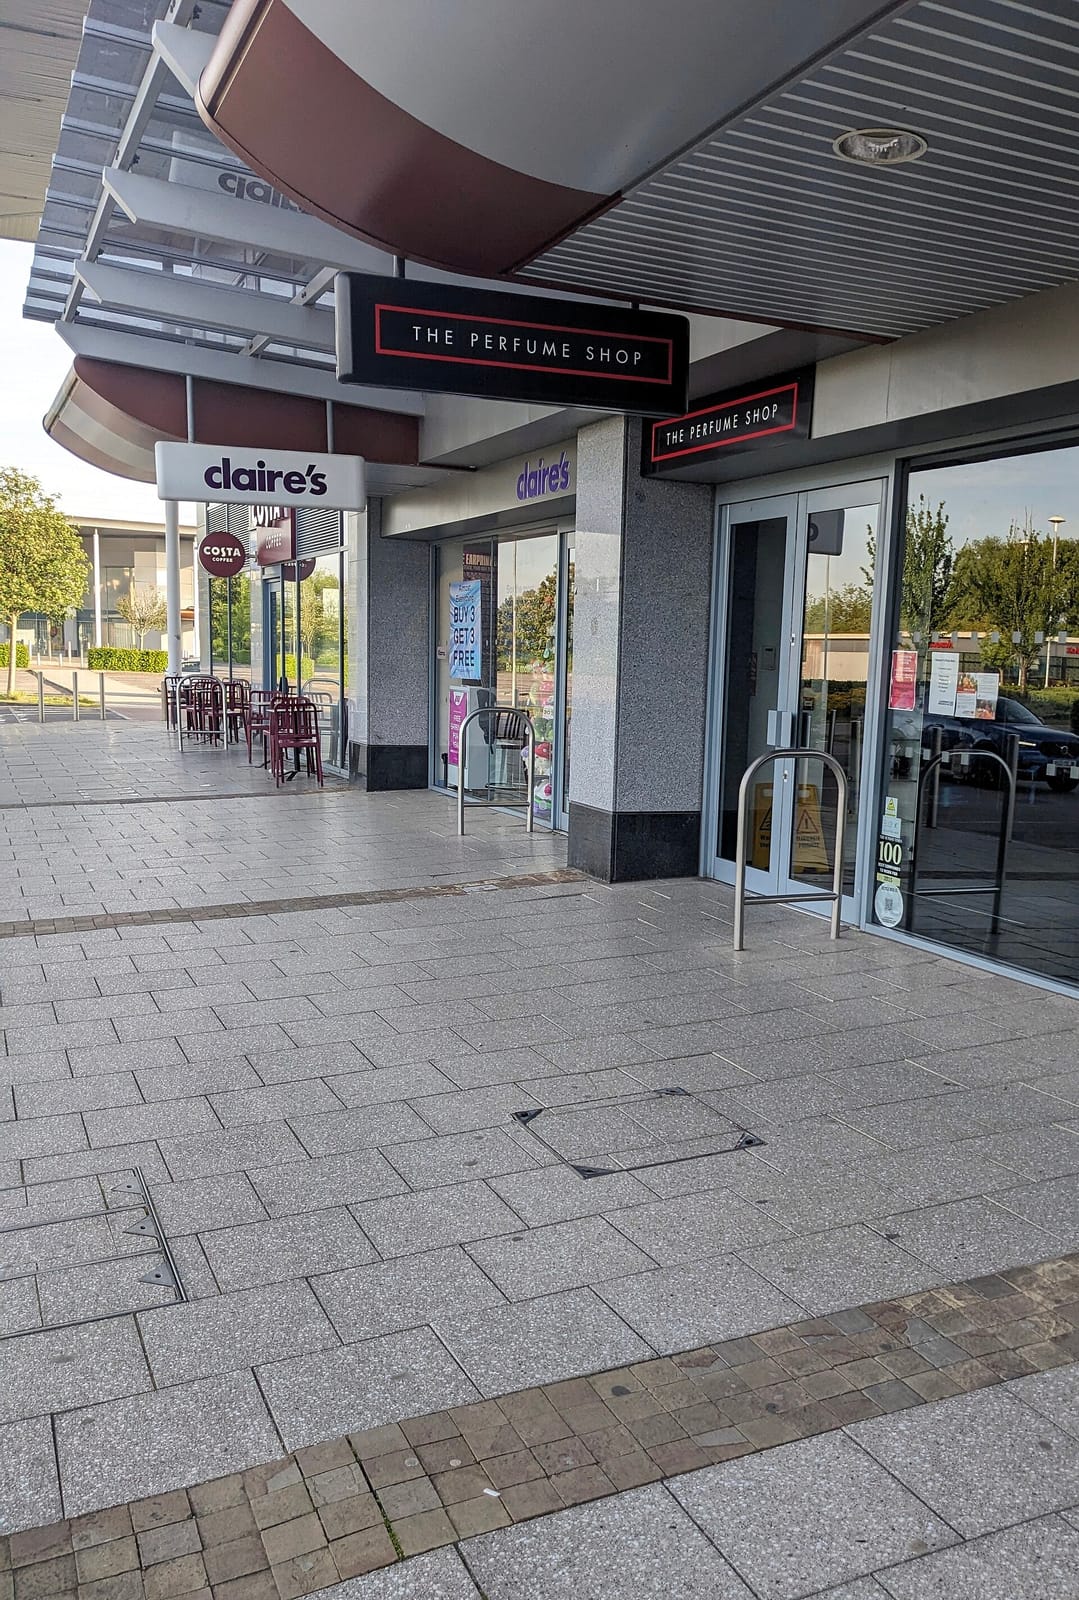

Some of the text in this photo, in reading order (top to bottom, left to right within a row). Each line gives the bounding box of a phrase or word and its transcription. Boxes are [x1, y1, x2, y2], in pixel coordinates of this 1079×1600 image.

[412, 326, 642, 366] THE PERFUME SHOP
[666, 403, 778, 446] THE PERFUME SHOP
[204, 457, 328, 495] claire's
[516, 451, 571, 501] claire's
[203, 546, 241, 557] COSTA
[453, 605, 475, 623] BUY 3
[453, 627, 475, 645] GET 3
[453, 650, 475, 667] FREE
[879, 841, 902, 865] 100
